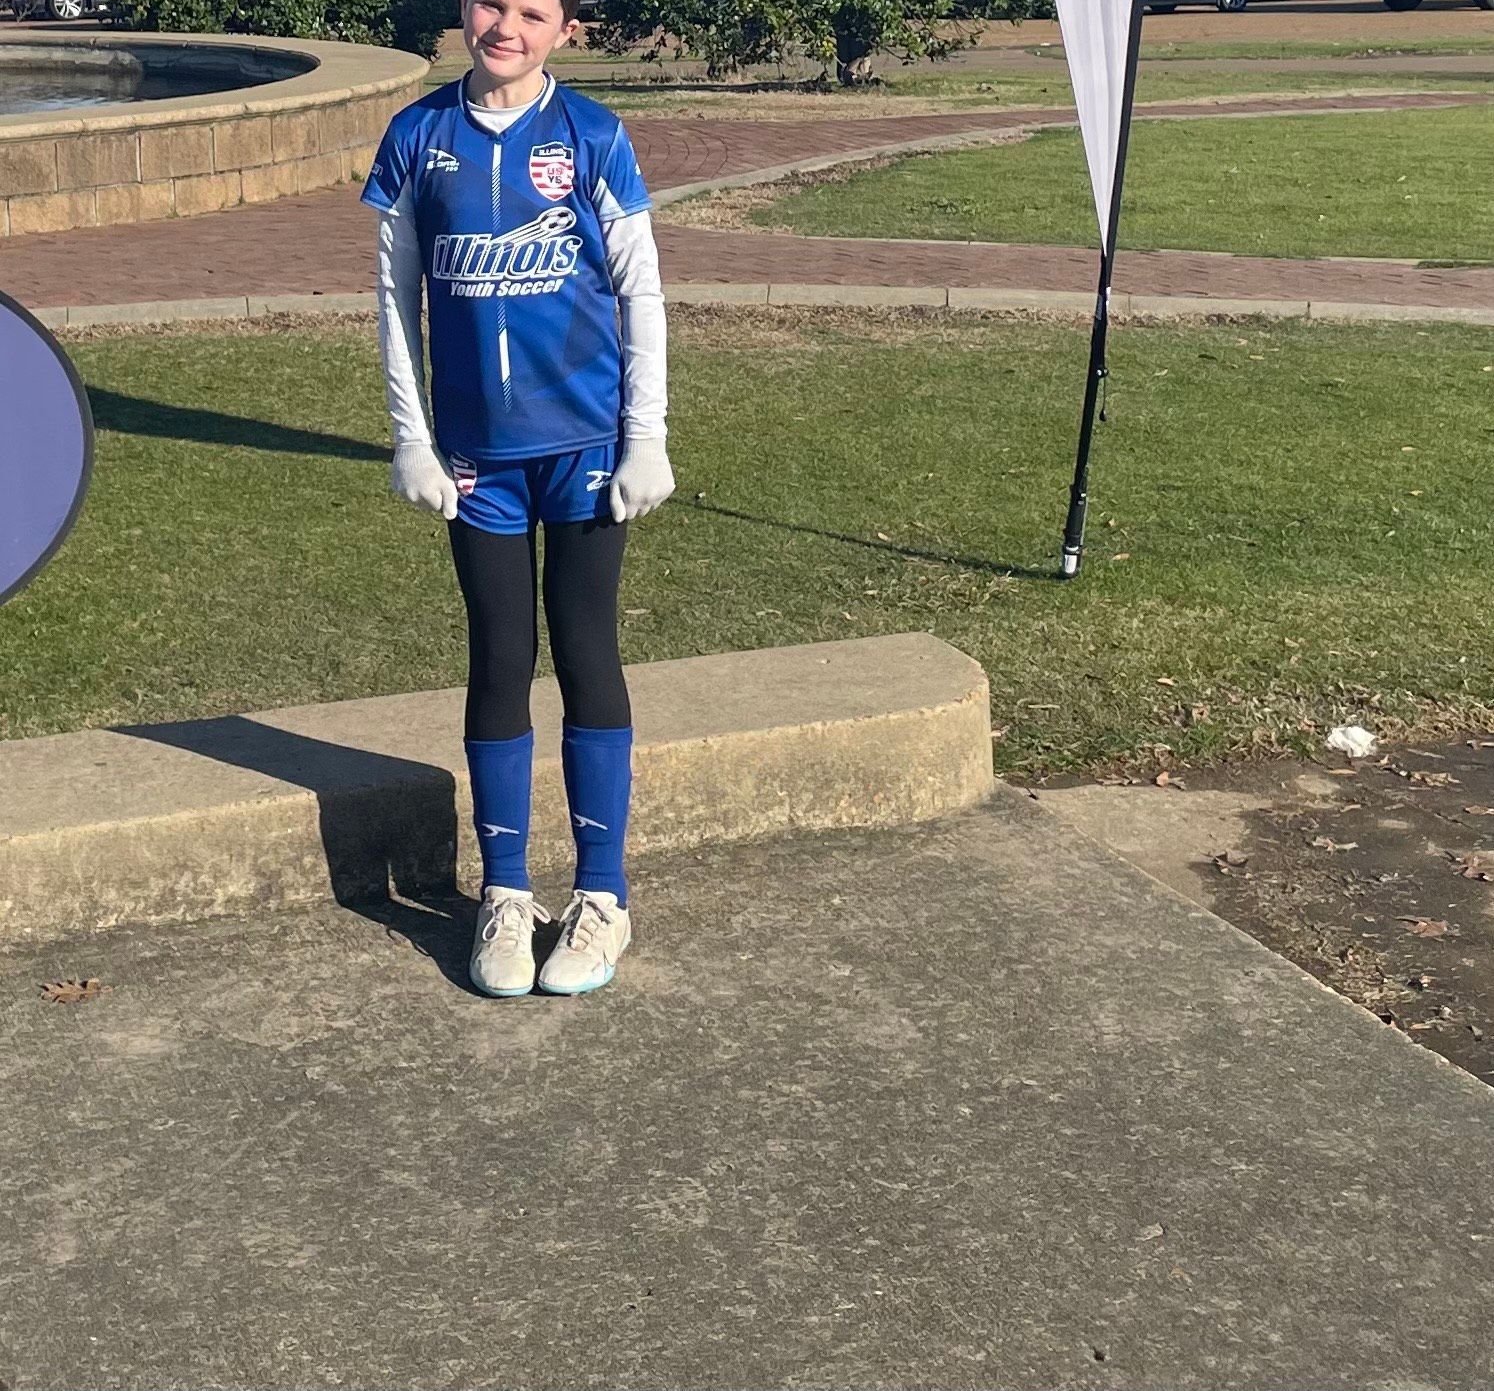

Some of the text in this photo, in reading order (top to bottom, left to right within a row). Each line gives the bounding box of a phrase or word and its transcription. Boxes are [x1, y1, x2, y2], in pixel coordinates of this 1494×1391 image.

[547, 175, 563, 184] YS
[450, 279, 564, 297] Youth Soccer
